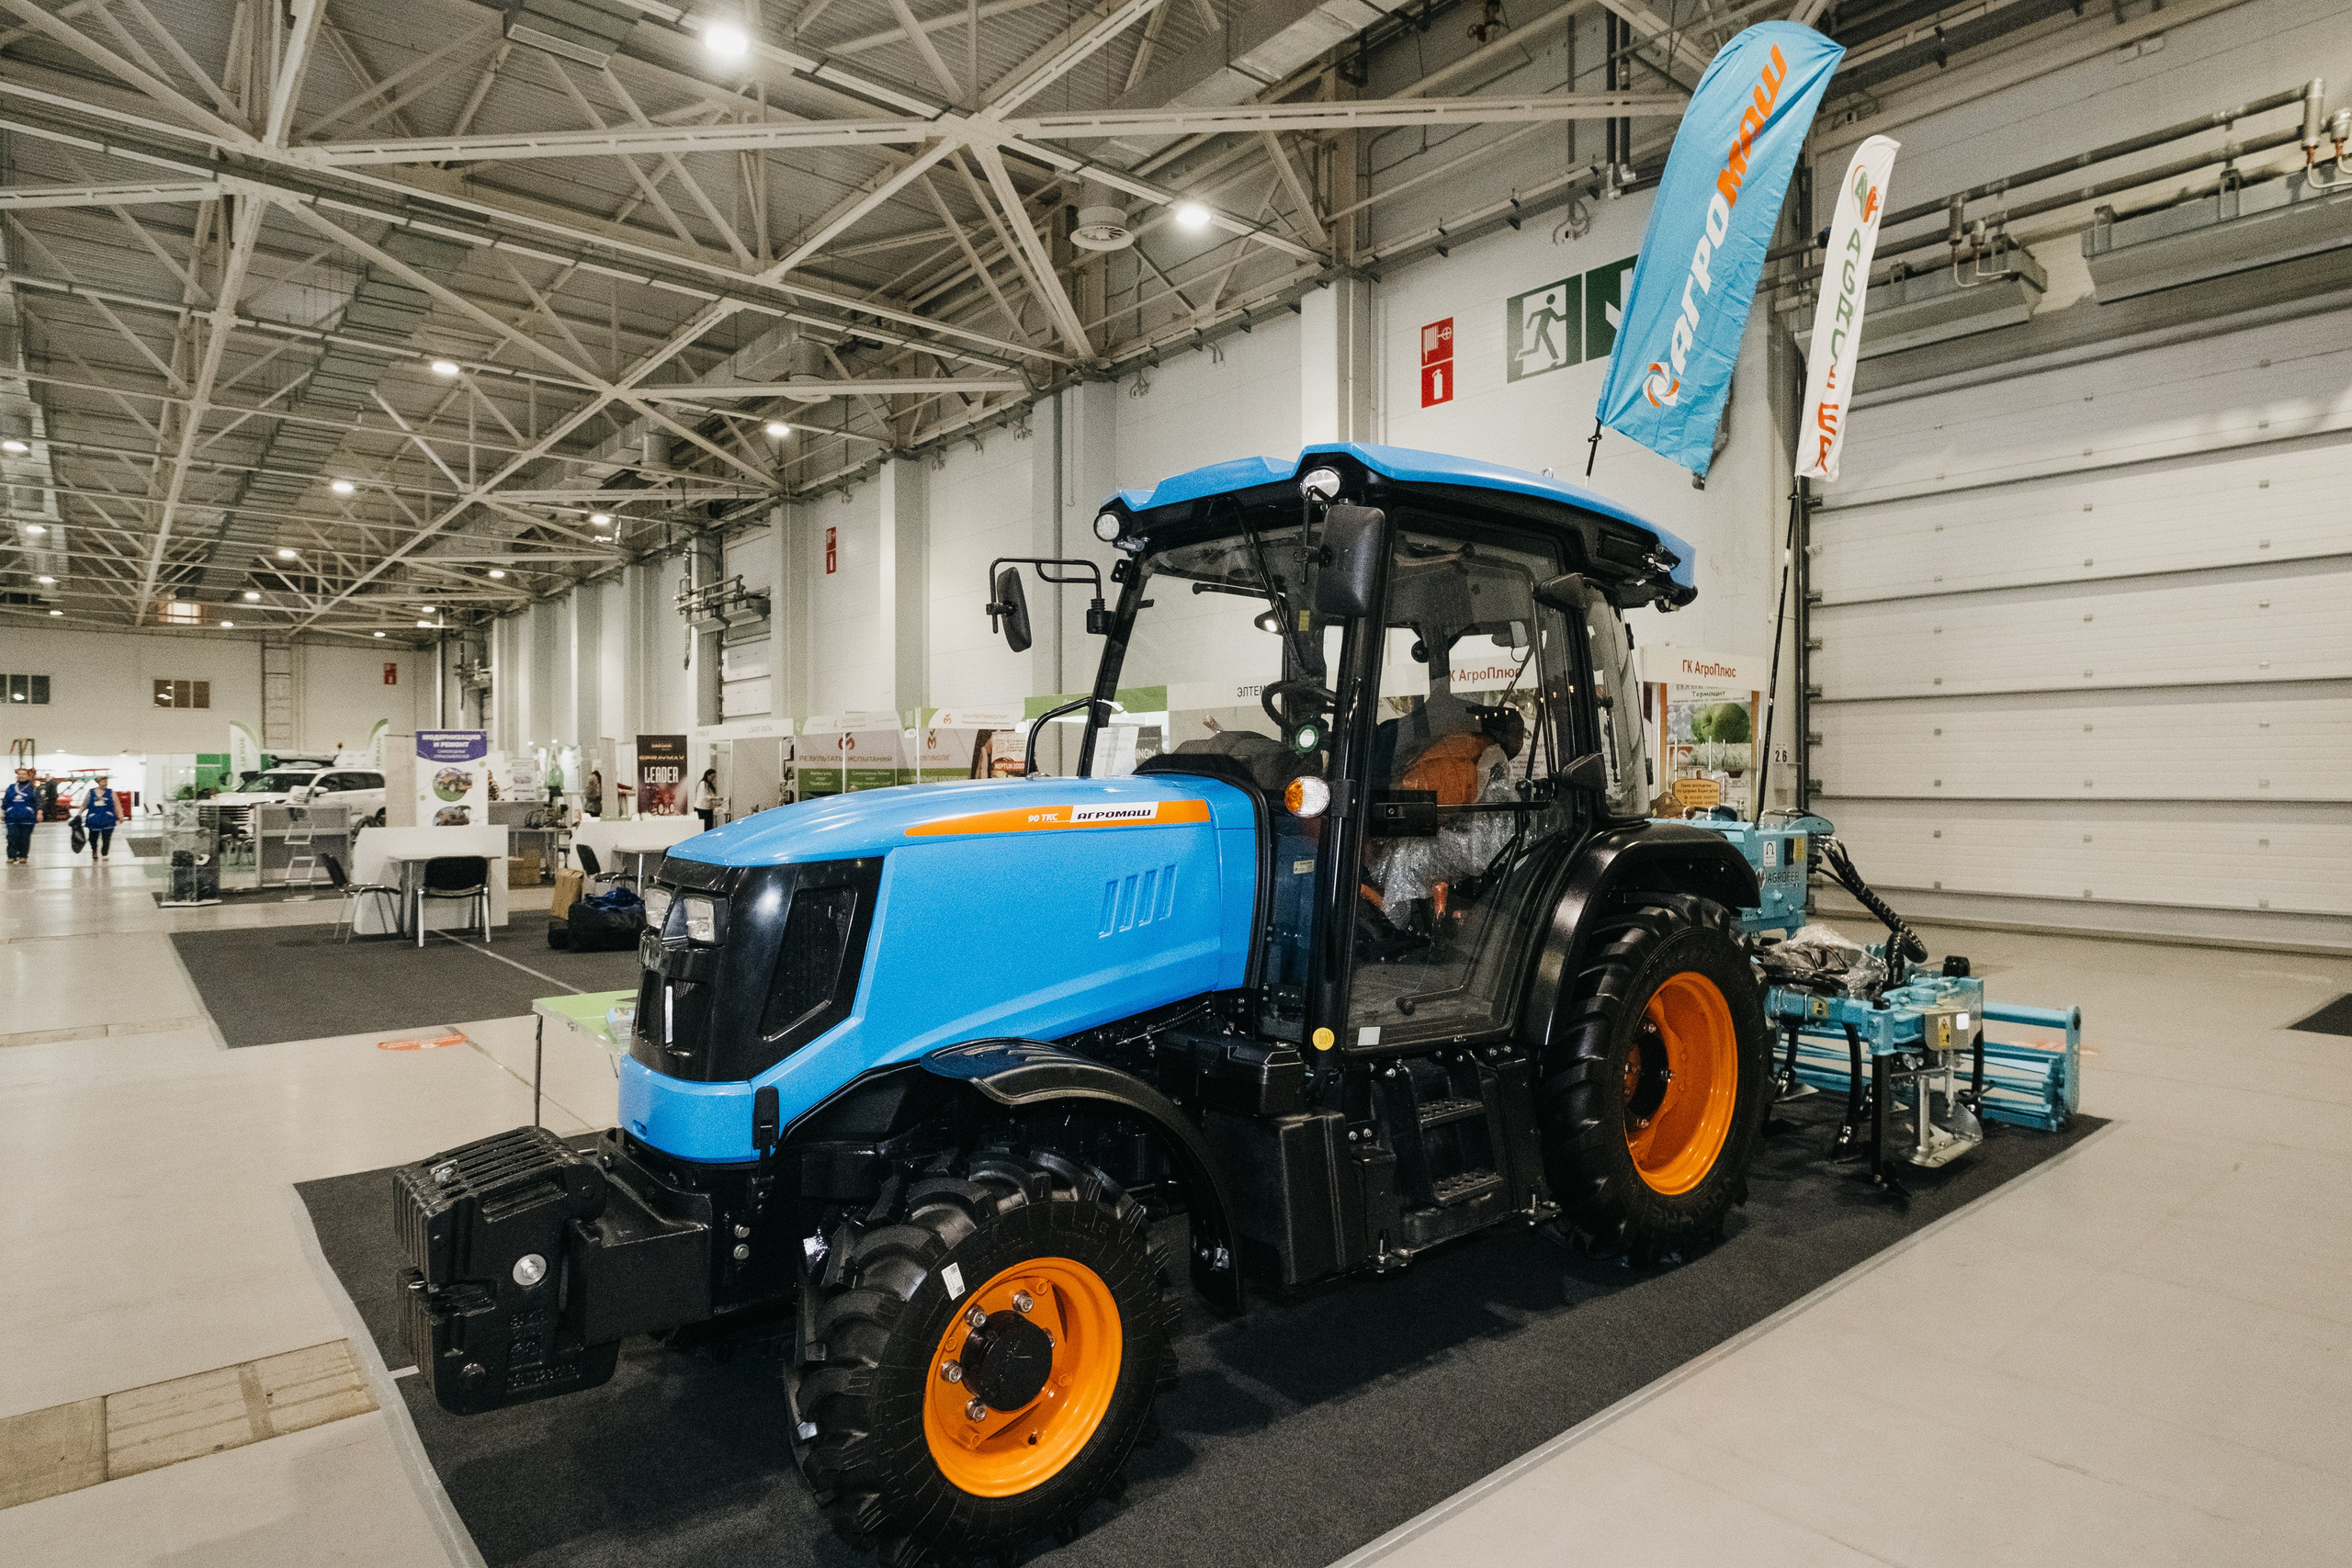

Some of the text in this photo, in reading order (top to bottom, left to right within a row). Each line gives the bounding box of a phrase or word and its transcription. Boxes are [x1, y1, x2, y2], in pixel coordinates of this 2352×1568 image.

[1670, 43, 1788, 375] АГРОМАШ
[1459, 667, 1521, 683] АгроПлюс
[1682, 660, 1736, 678] ГК АгроПлюс
[1775, 750, 1788, 762] 26
[644, 766, 679, 784] LEADER
[1027, 809, 1151, 822] 90 ТКС АГРОМАШ
[1767, 871, 1800, 884] AGROFER
